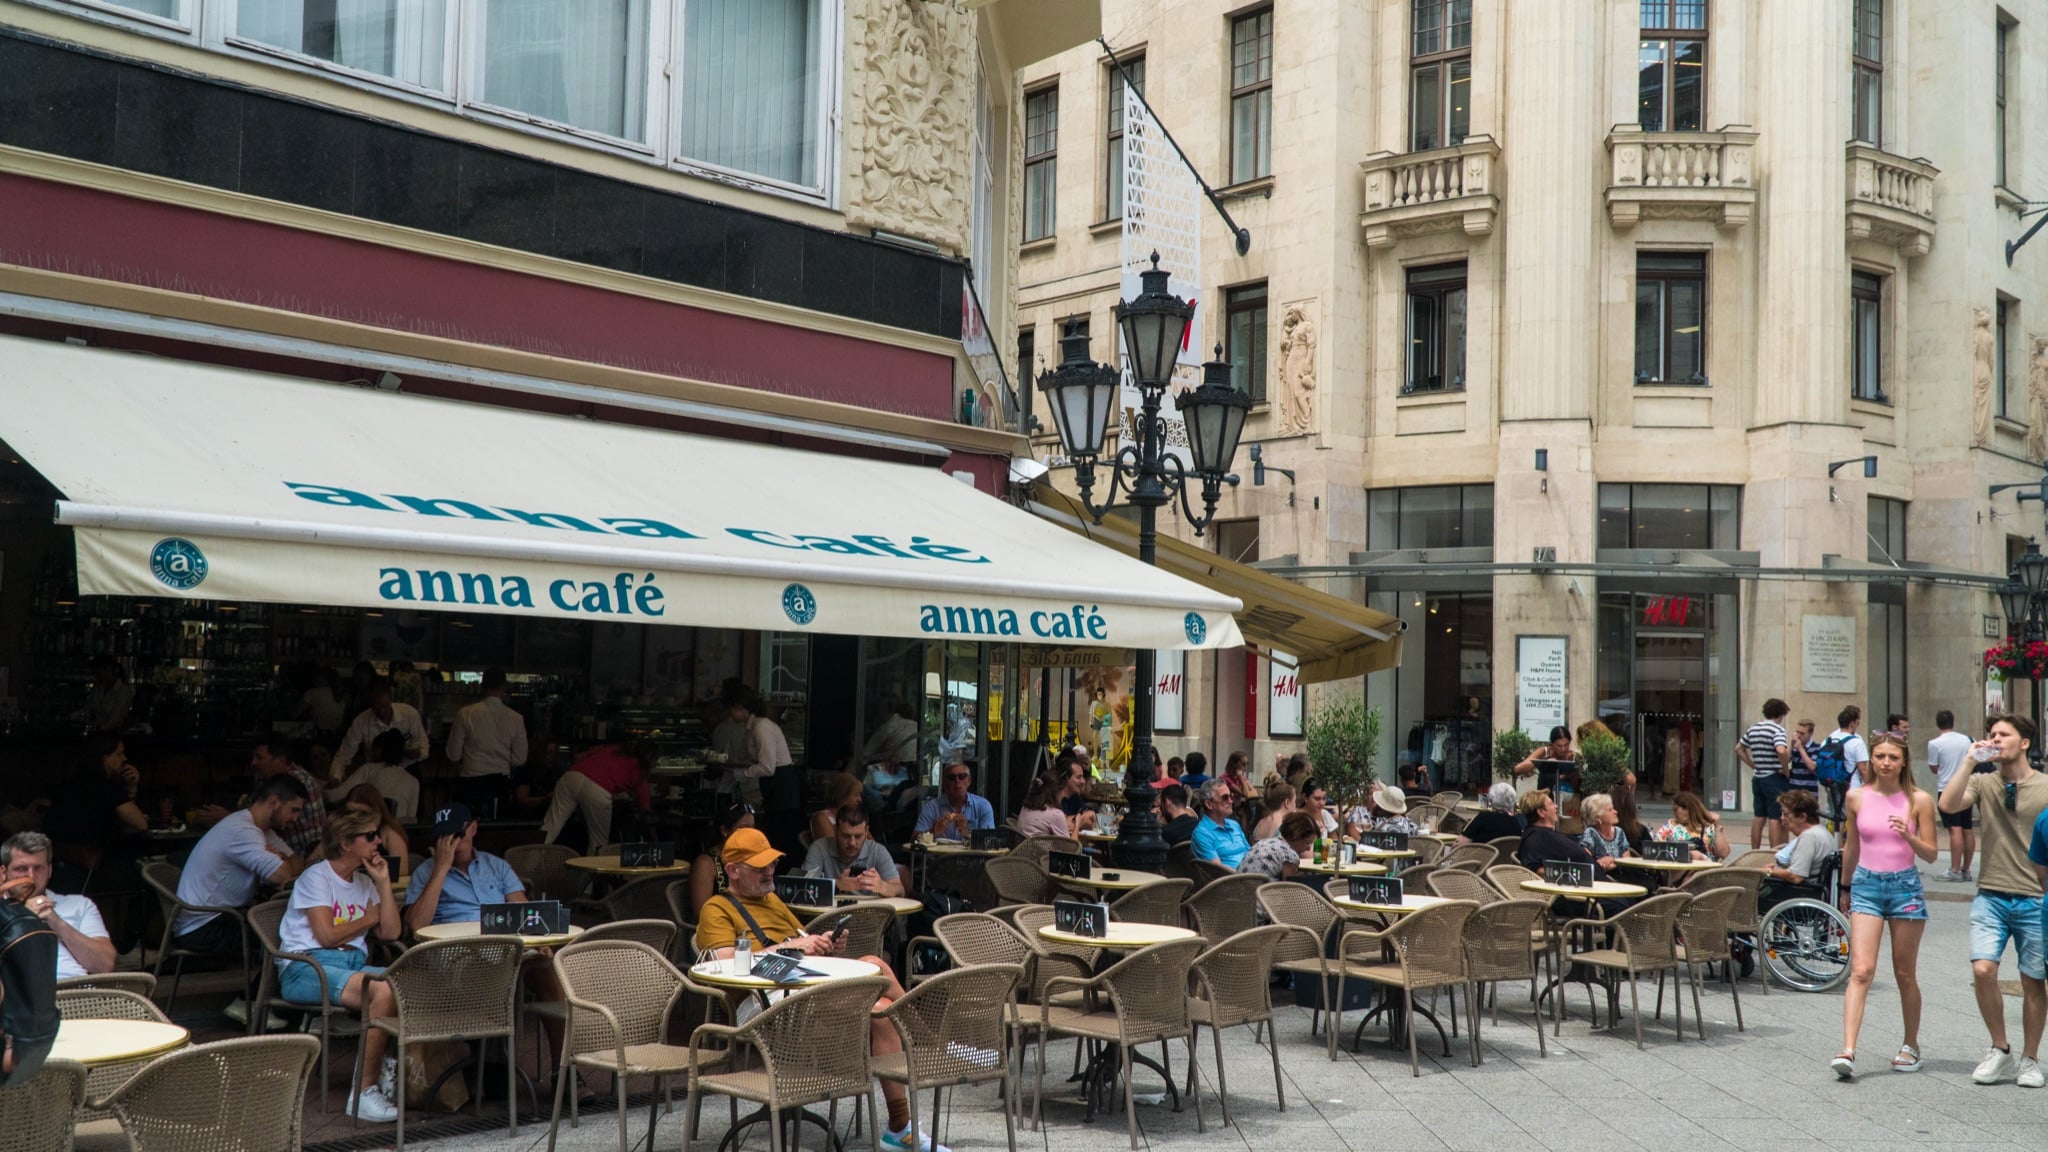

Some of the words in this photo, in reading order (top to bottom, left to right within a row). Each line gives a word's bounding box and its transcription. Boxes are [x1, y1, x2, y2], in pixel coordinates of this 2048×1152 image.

[287, 482, 708, 540] anna
[725, 527, 992, 564] café
[171, 554, 190, 573] a
[154, 564, 179, 587] anna
[184, 566, 205, 586] café
[380, 567, 535, 608] anna
[549, 572, 665, 616] café
[920, 604, 1022, 636] anna
[1030, 604, 1108, 640] café
[1642, 595, 1690, 628] H&M
[1157, 674, 1181, 695] H&M
[1273, 675, 1298, 697] H&M
[435, 809, 452, 824] NY
